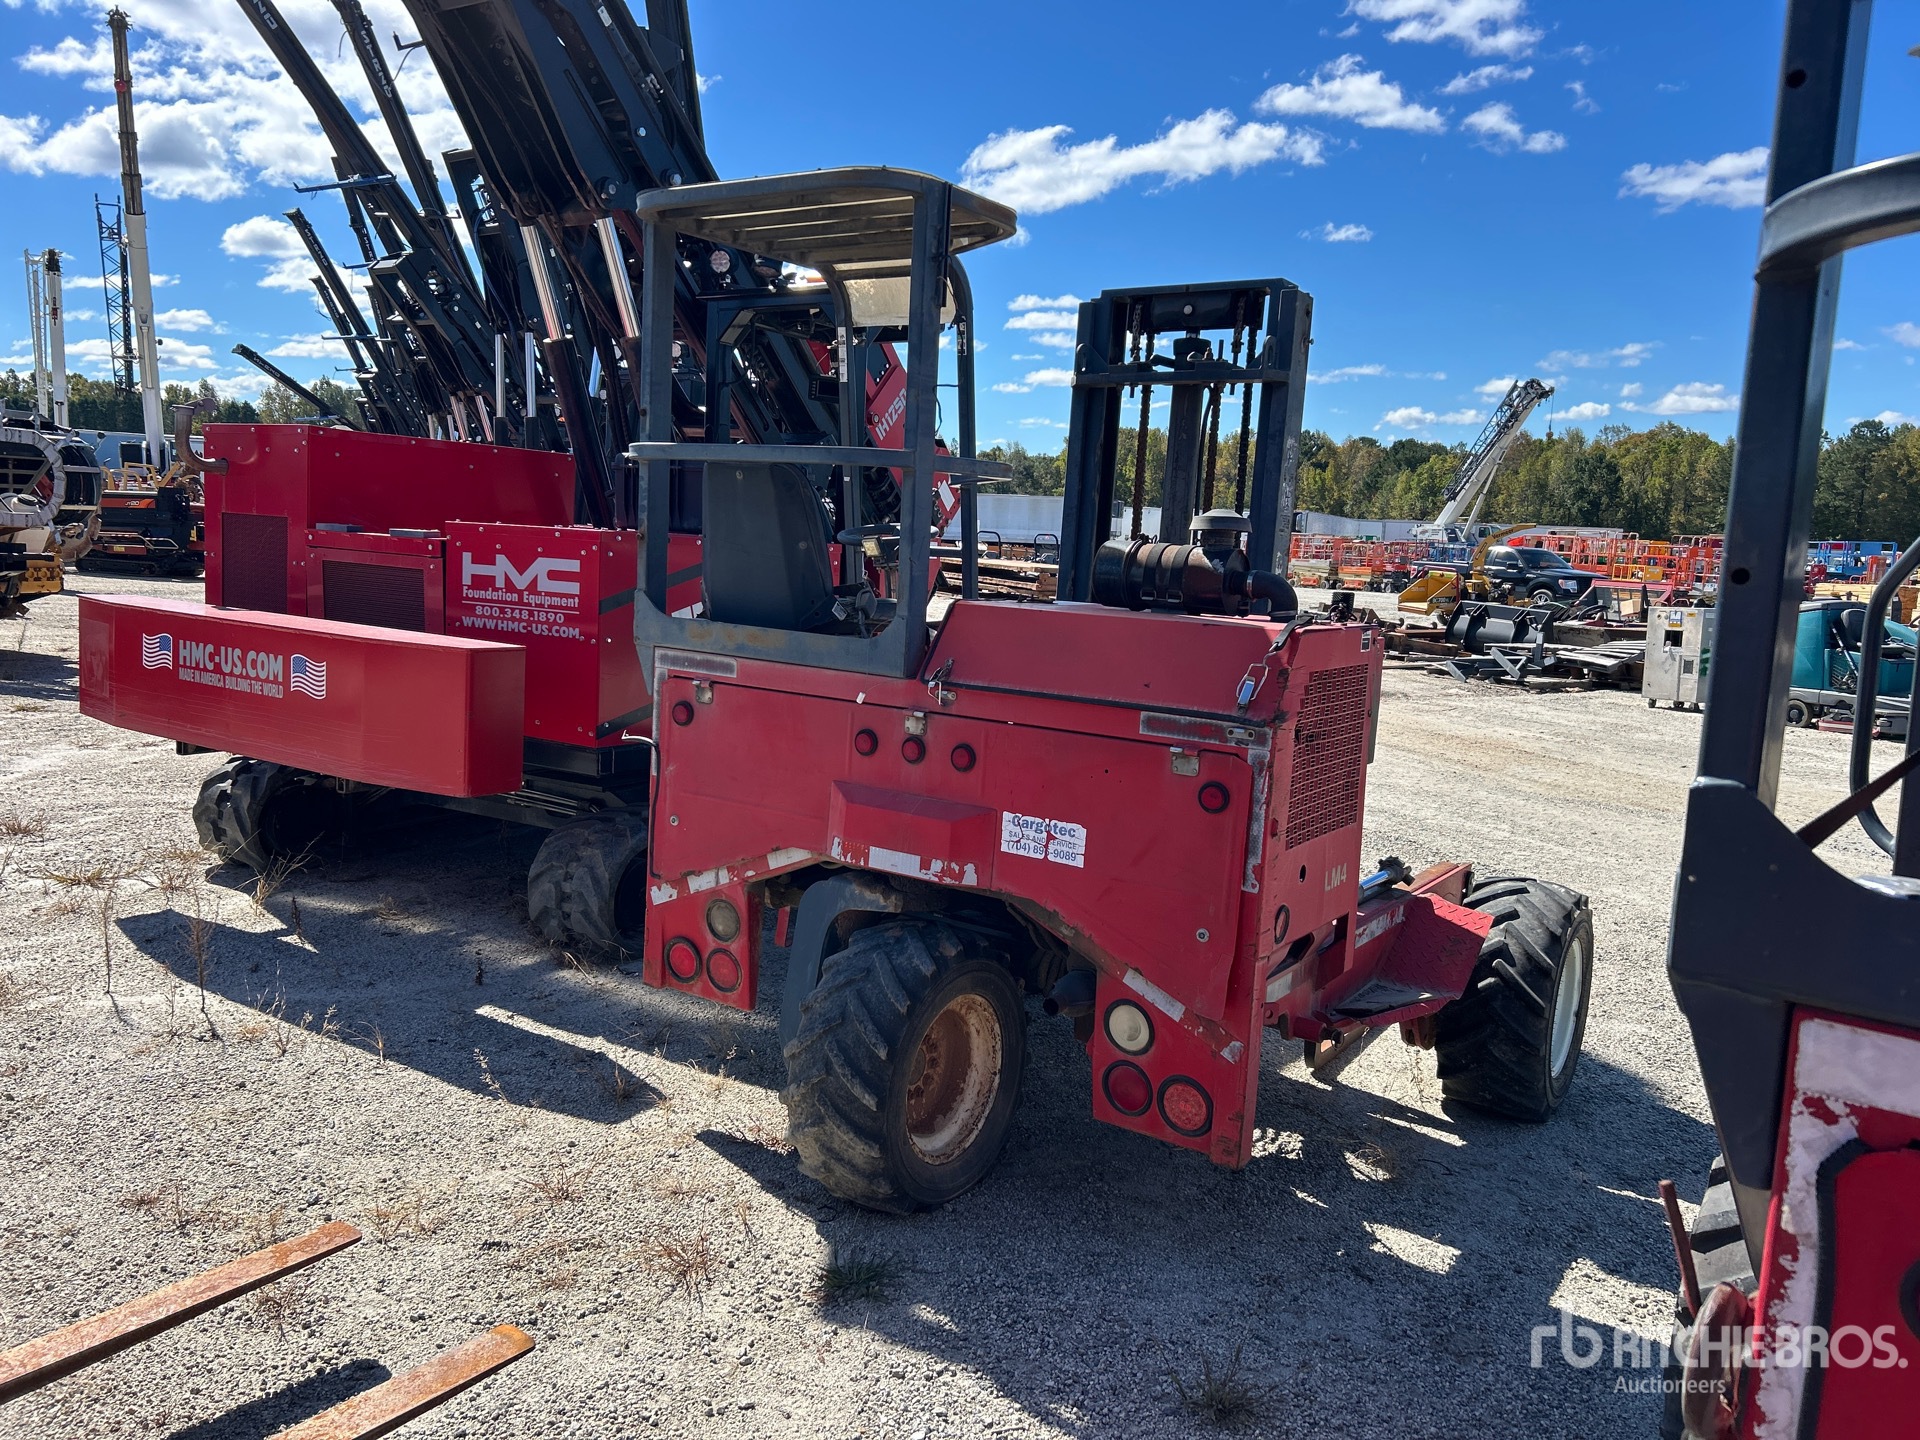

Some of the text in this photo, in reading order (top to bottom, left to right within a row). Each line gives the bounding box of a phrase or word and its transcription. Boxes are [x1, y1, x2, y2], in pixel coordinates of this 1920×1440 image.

[462, 551, 580, 595] HMC
[463, 586, 580, 608] Foundation Equipment
[475, 606, 564, 623] 800.348.1890
[179, 639, 284, 682] HMC-US.COM
[179, 667, 283, 698] MADE IN AMERICA BUILDING THE WORLD
[1012, 815, 1076, 838] Cargotec
[1008, 841, 1030, 854] (704)
[1032, 835, 1046, 844] AND
[1049, 840, 1077, 850] ERVICE
[1325, 863, 1347, 891] LM4
